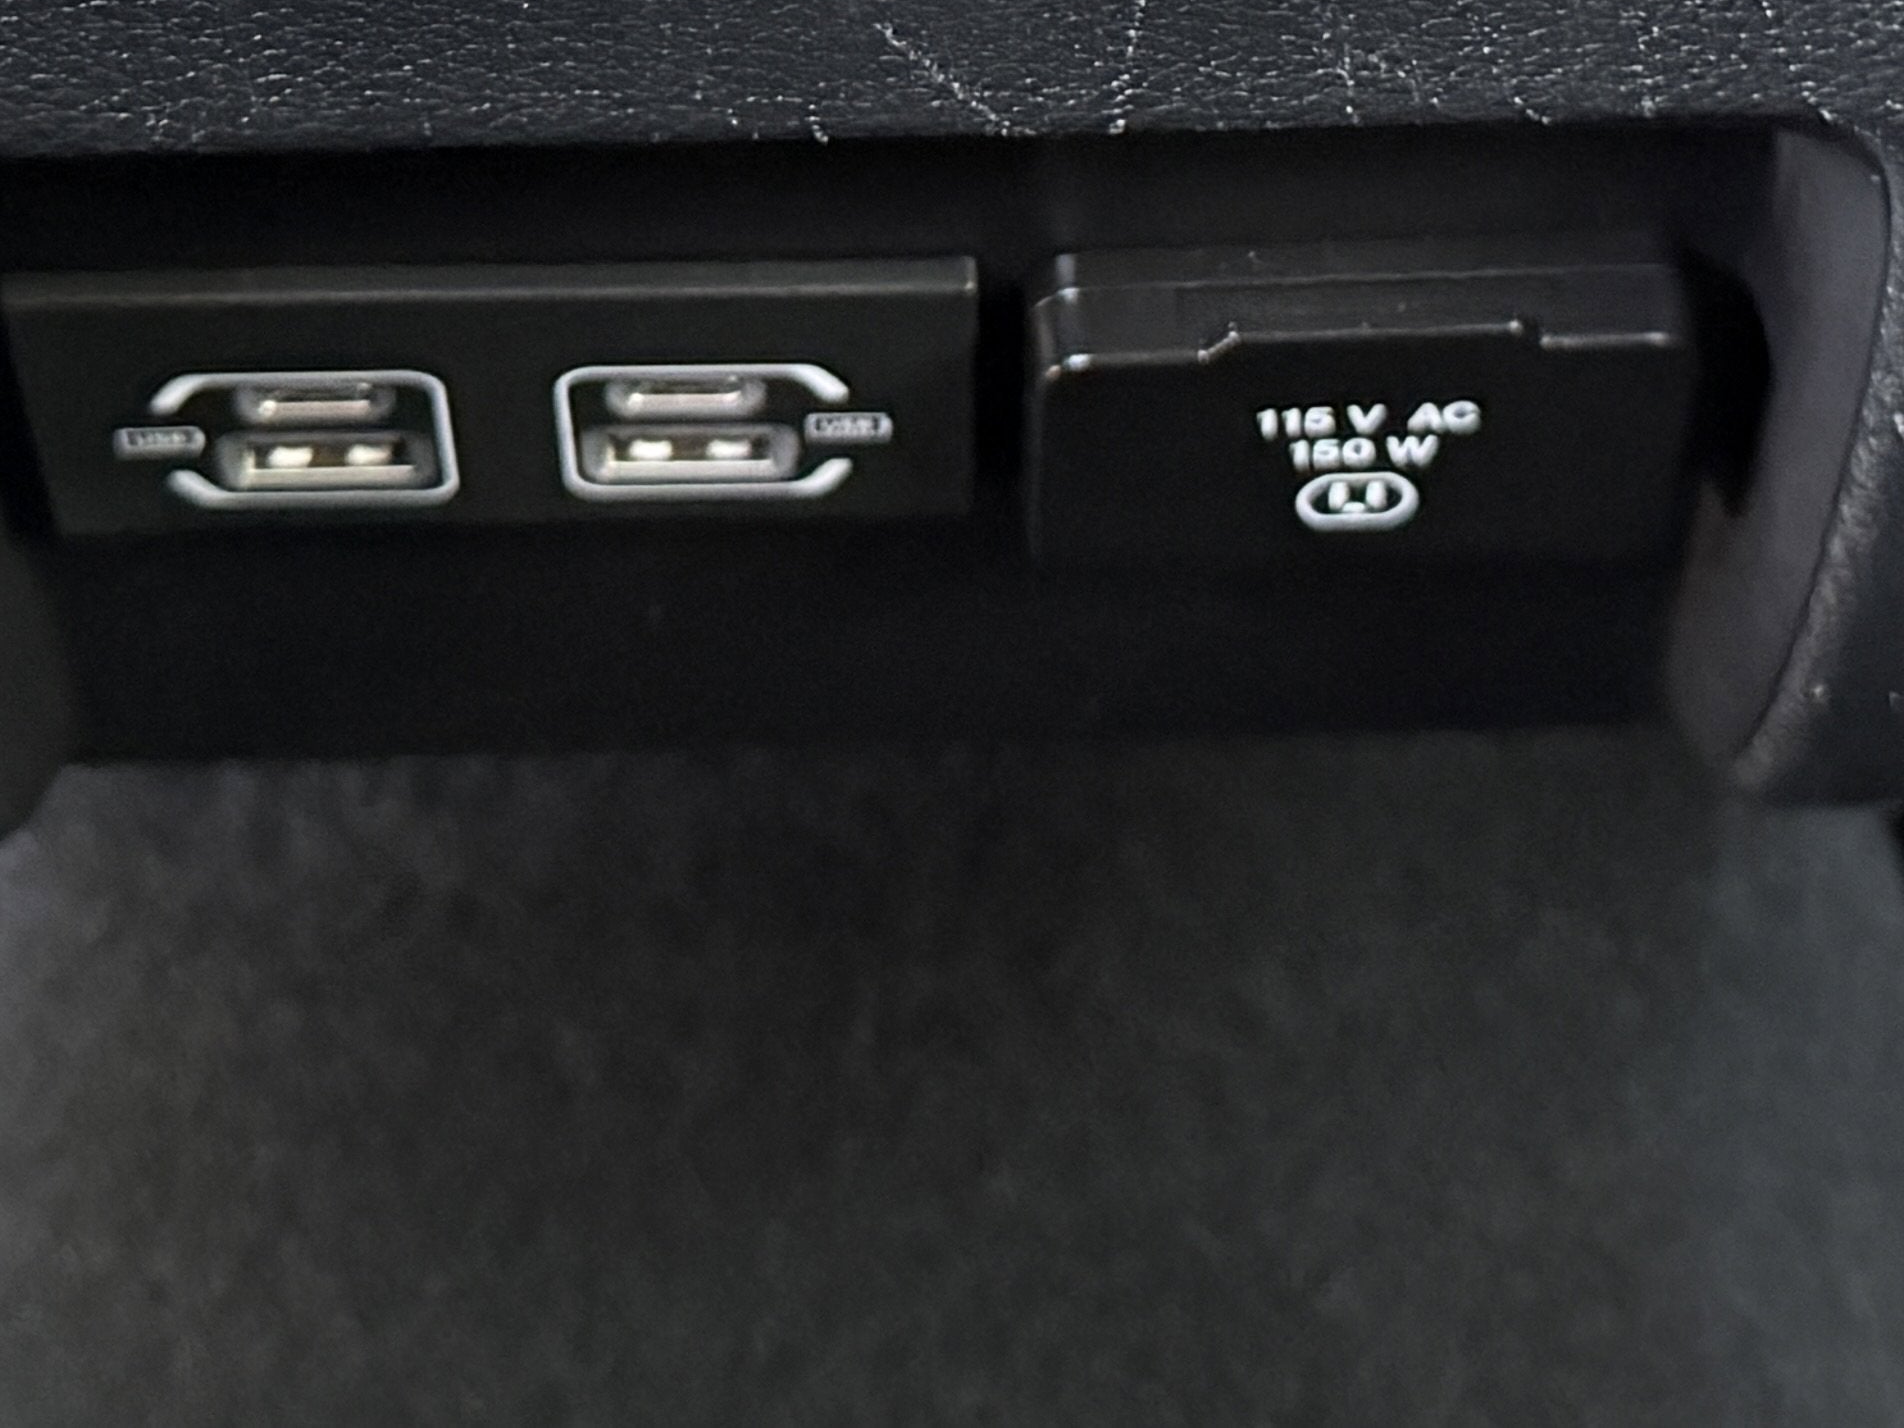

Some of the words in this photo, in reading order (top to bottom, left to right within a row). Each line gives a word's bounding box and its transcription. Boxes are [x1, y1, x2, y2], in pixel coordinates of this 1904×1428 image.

[1255, 405, 1337, 441] 115
[1346, 402, 1387, 434] V
[1406, 399, 1482, 435] AC
[1289, 437, 1377, 472] 150
[1385, 433, 1439, 468] W
